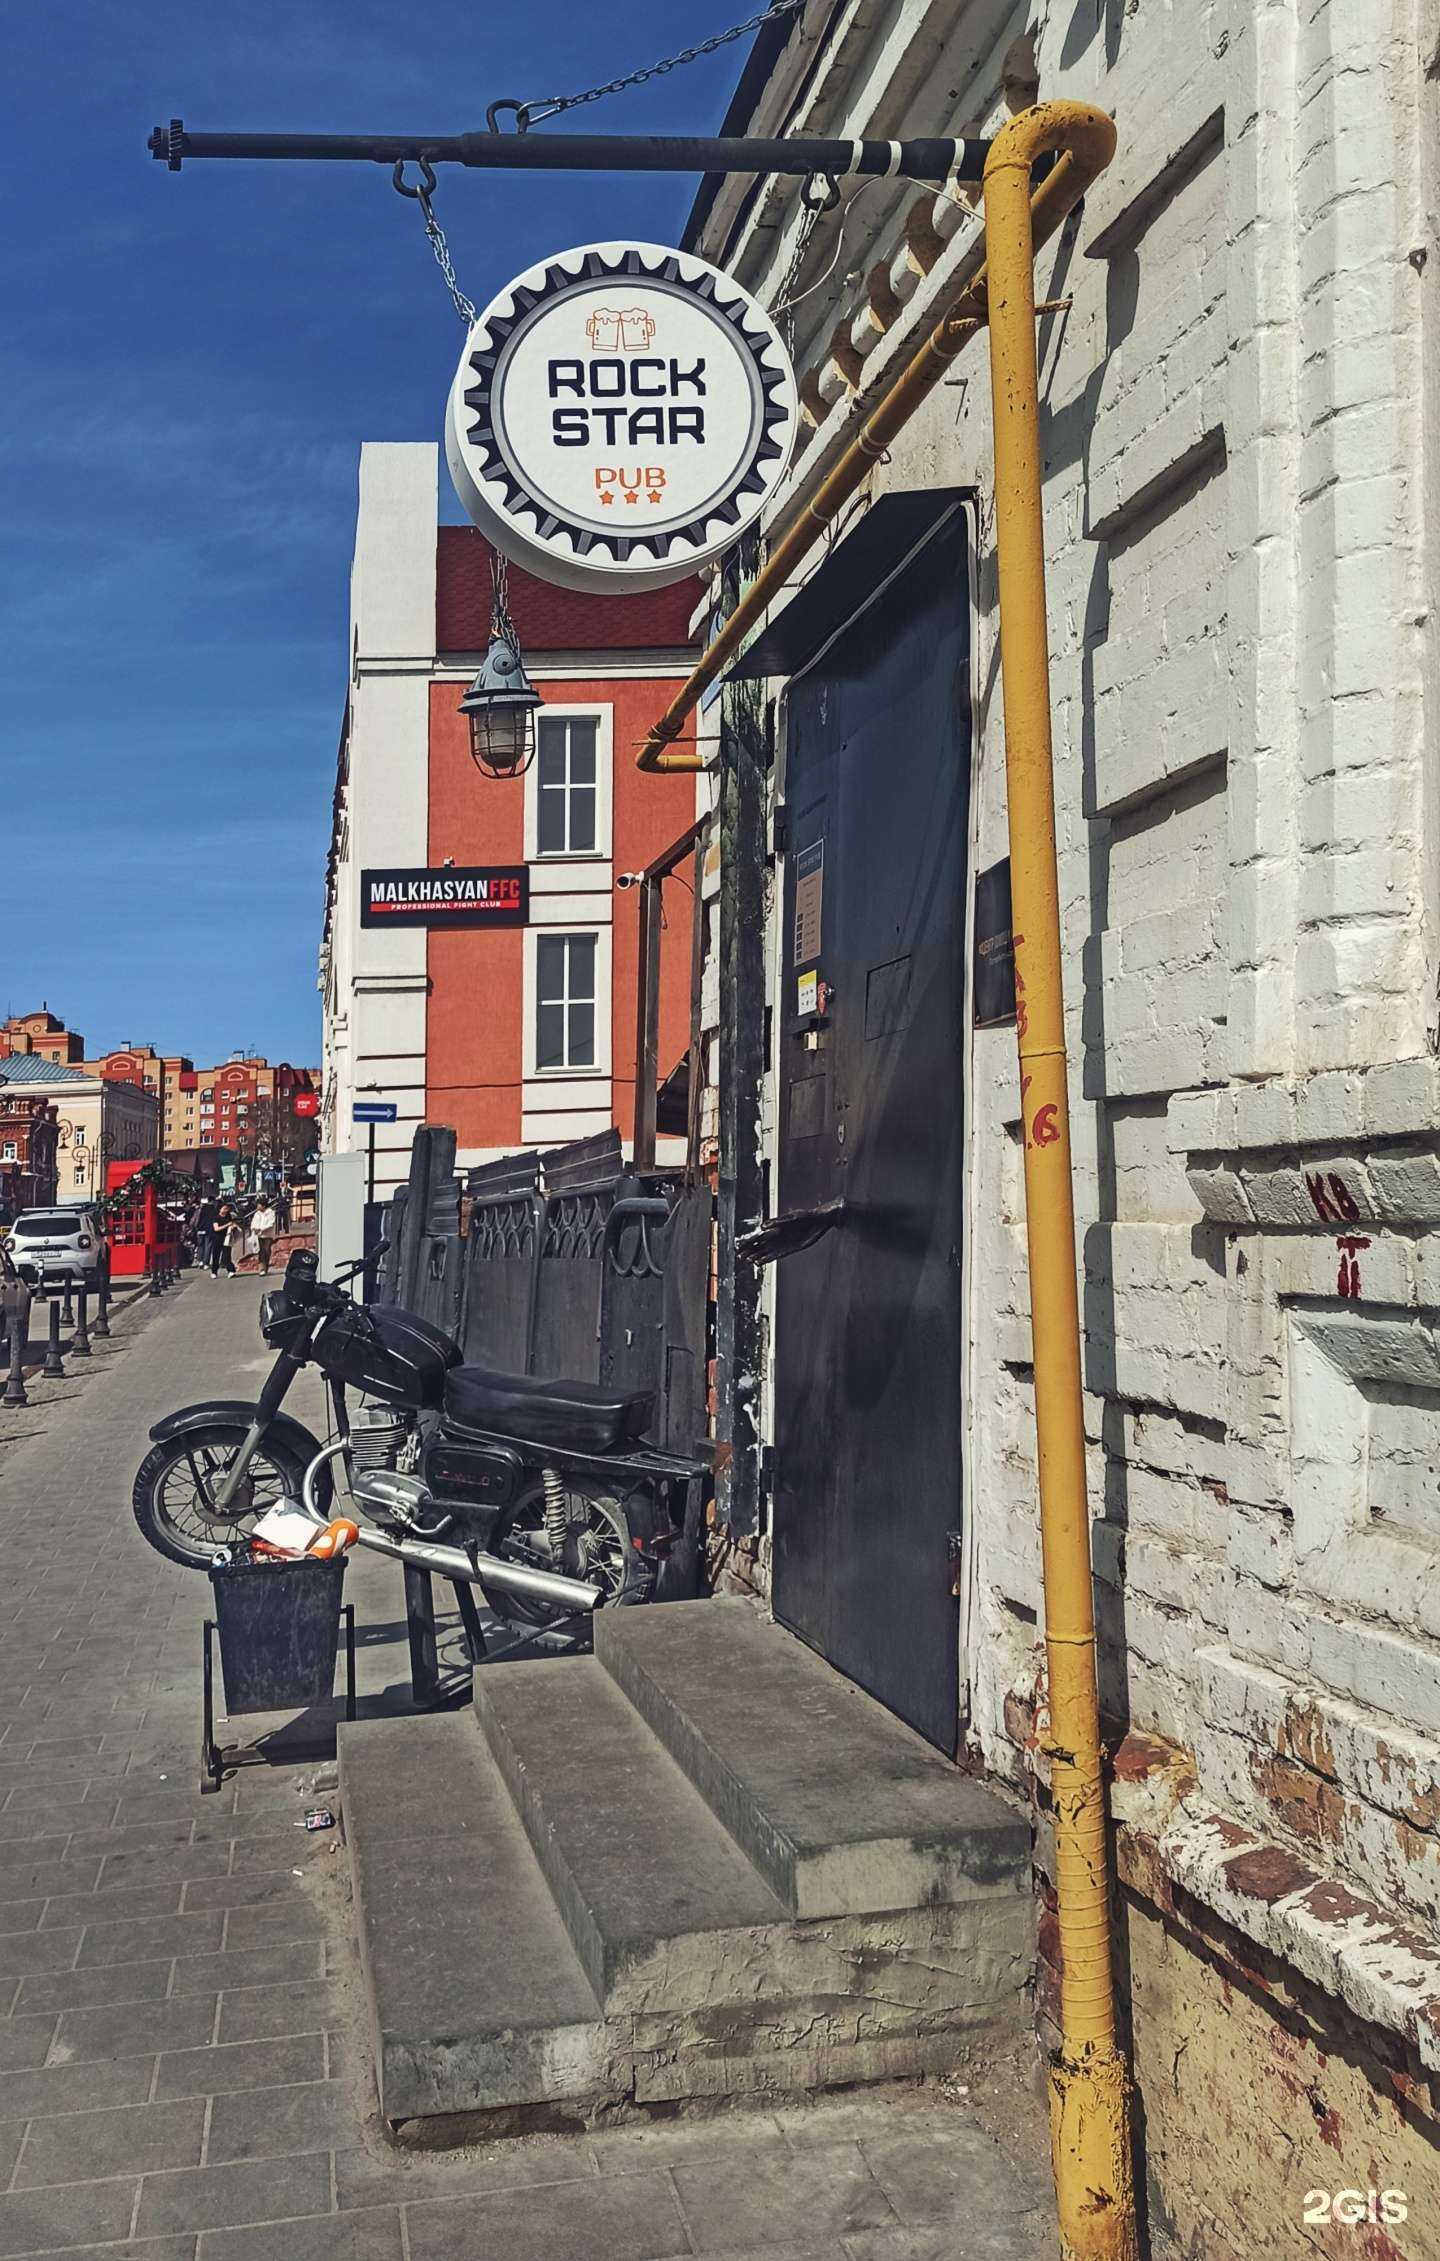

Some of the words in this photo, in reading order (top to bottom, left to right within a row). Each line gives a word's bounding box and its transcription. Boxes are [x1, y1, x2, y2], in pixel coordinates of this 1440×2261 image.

[548, 358, 707, 398] ROCK
[552, 406, 705, 446] STAR
[594, 467, 667, 489] PUB
[391, 902, 451, 910] PROFESSIONAL
